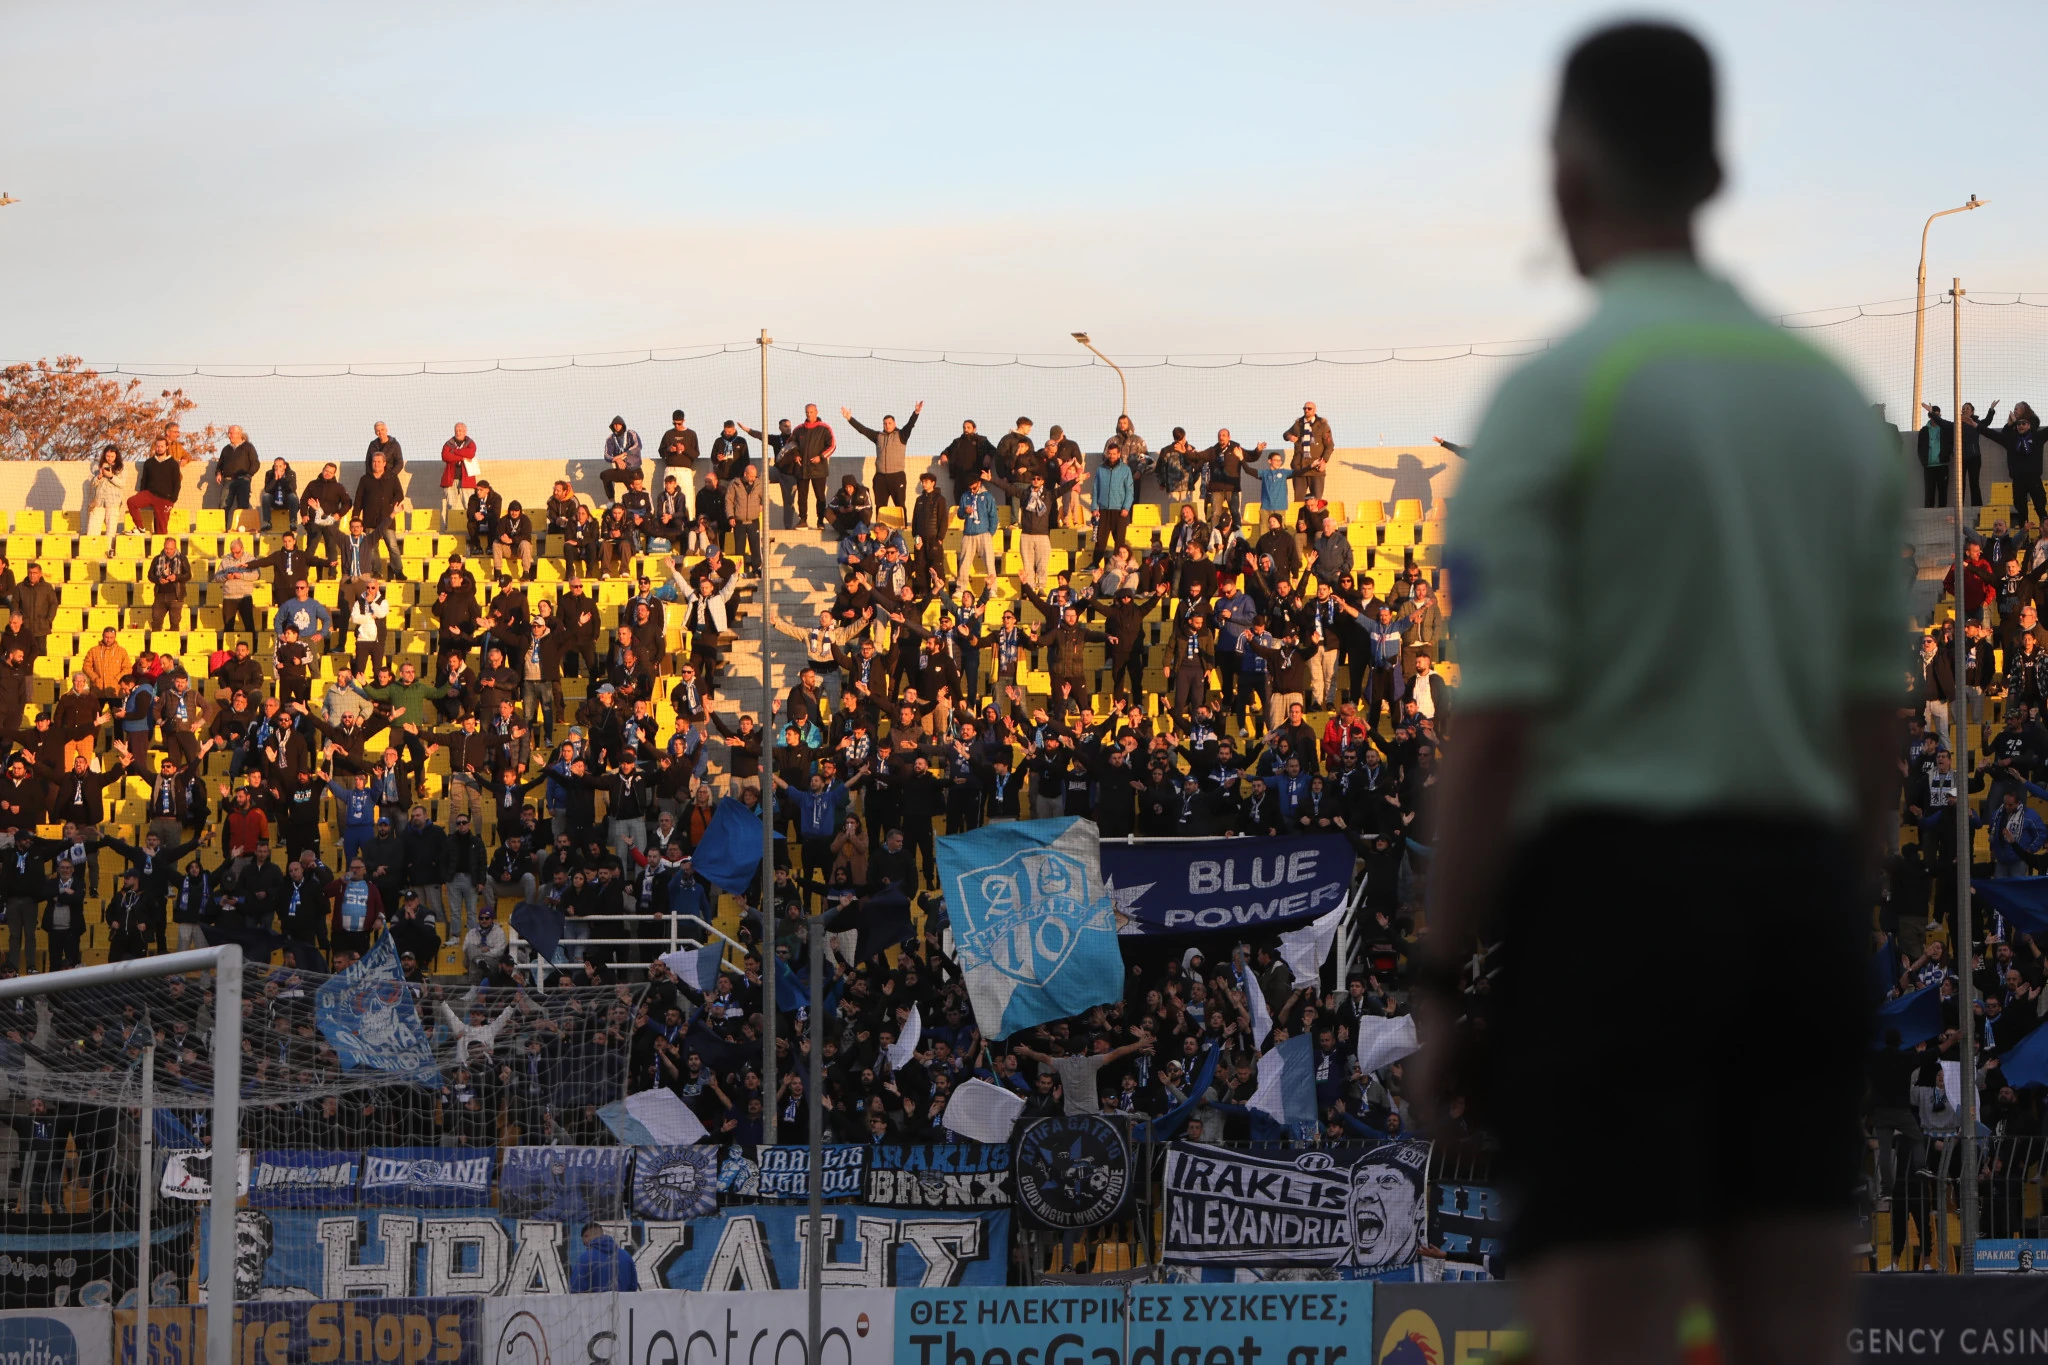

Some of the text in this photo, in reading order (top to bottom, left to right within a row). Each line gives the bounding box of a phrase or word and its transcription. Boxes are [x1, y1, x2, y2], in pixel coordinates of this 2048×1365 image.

[1188, 850, 1320, 894] BLUE
[1164, 882, 1341, 927] POWER
[762, 1146, 863, 1170] IRALIS
[871, 1143, 1011, 1173] IRAKLIS
[1021, 1118, 1064, 1166] ANTIFA
[1068, 1117, 1113, 1143] GATE
[759, 1168, 862, 1194] NEAOLI
[1021, 1169, 1124, 1224] GOOD NIGHT WHITE PRIDE
[1172, 1153, 1349, 1210] IRAKLIS
[1168, 1195, 1351, 1245] ALEXANDRIA
[54, 1257, 77, 1278] 10
[1977, 1250, 2016, 1260] ΗΡΑΚΛΗΣ
[910, 1294, 1348, 1326] ΘΕΣ ΗΛΕΚΤΡΙΚΕΣ ΣΥΣΚΕΥΕΣ;
[307, 1302, 461, 1365] Shops
[910, 1330, 1346, 1365] ThesGadgetgr
[1960, 1327, 2048, 1354] CASIN
